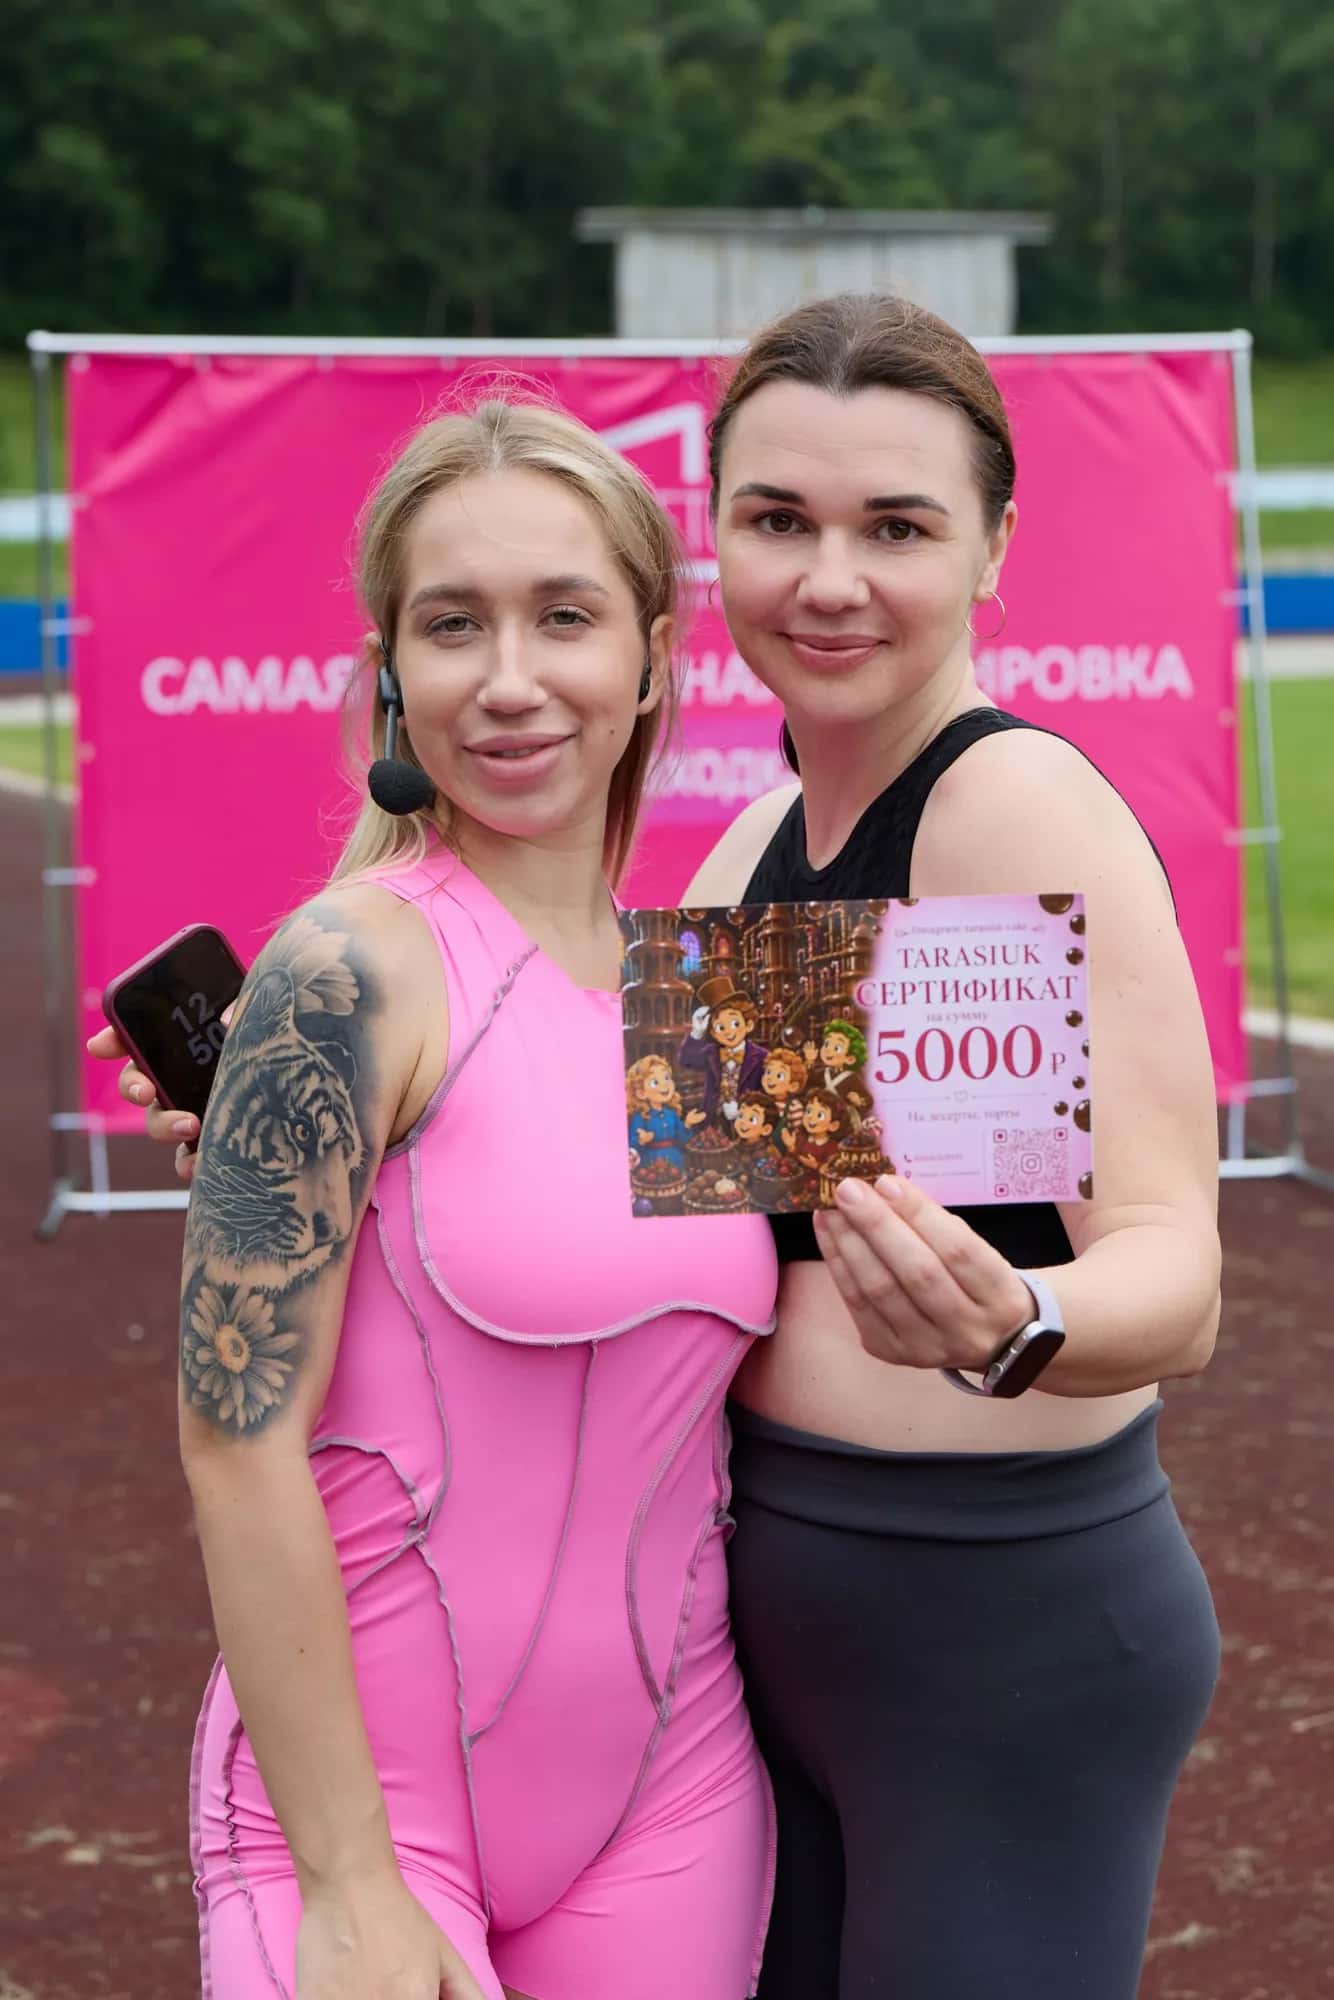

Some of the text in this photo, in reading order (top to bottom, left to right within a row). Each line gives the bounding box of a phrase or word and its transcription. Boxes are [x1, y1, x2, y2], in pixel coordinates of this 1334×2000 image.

[975, 645, 1193, 701] ИРОВКА
[898, 944, 1040, 969] TARASIUK
[856, 975, 1078, 1007] СЕРТИФИКАТ
[171, 992, 216, 1033] 12
[187, 1021, 227, 1065] 50
[875, 1024, 1042, 1083] 5000
